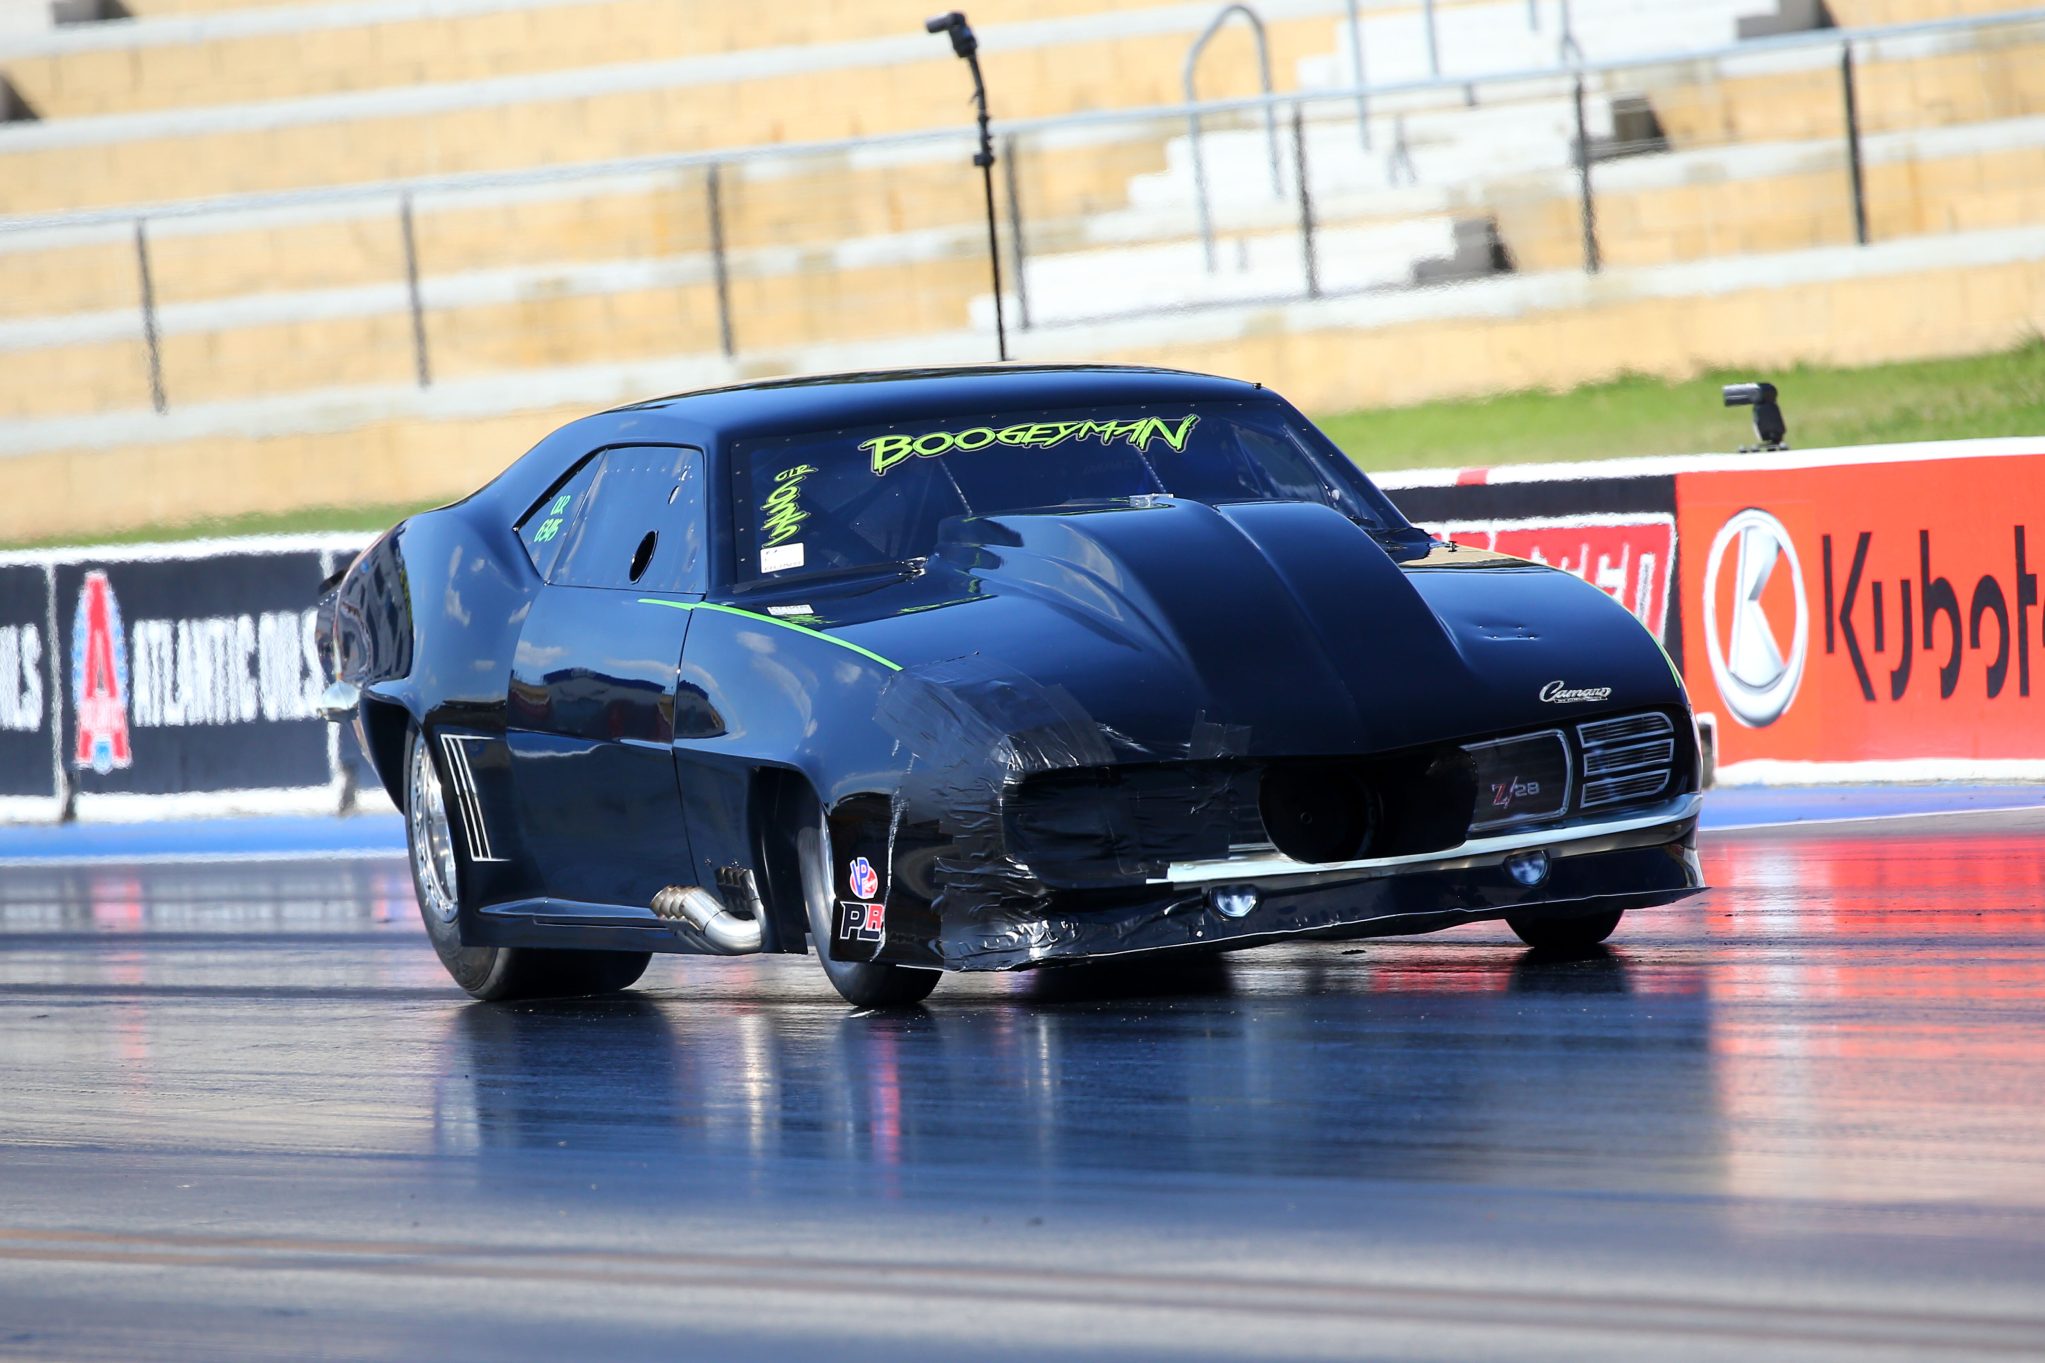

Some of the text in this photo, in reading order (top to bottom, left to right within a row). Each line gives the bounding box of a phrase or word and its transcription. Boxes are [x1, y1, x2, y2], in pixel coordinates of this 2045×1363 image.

[859, 414, 1200, 475] BOOGEYMAN
[1821, 525, 2045, 701] Kubot
[1539, 680, 1612, 702] Camaro
